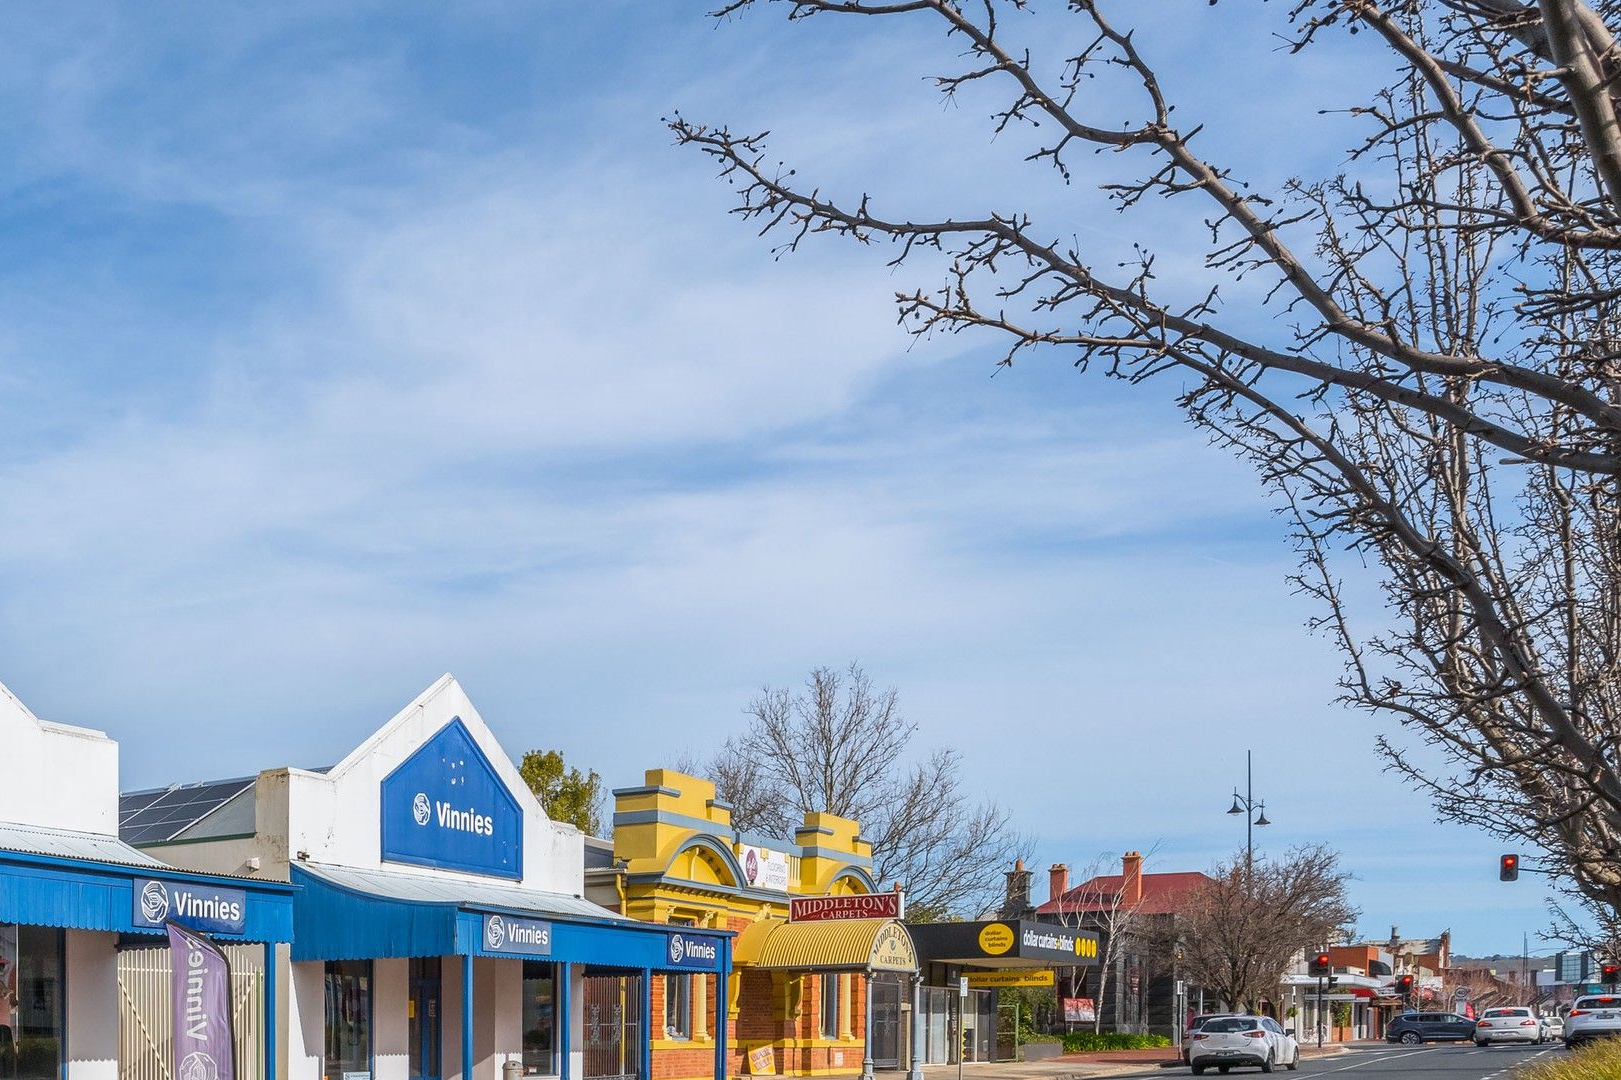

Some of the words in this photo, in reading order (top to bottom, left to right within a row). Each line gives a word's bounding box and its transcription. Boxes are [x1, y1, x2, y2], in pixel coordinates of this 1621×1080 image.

[436, 800, 494, 836] Vinnies
[174, 891, 240, 921] Vinnies
[794, 895, 897, 920] MIDDLETON'S
[820, 909, 868, 920] CARPETS
[508, 922, 548, 945] Vinnies
[1023, 929, 1038, 947] dollar
[685, 940, 716, 960] Vinnies
[873, 926, 912, 963] MIDDLETON'S
[880, 955, 906, 966] CARPETS
[989, 975, 1020, 983] curtains
[1024, 974, 1048, 982] blinds
